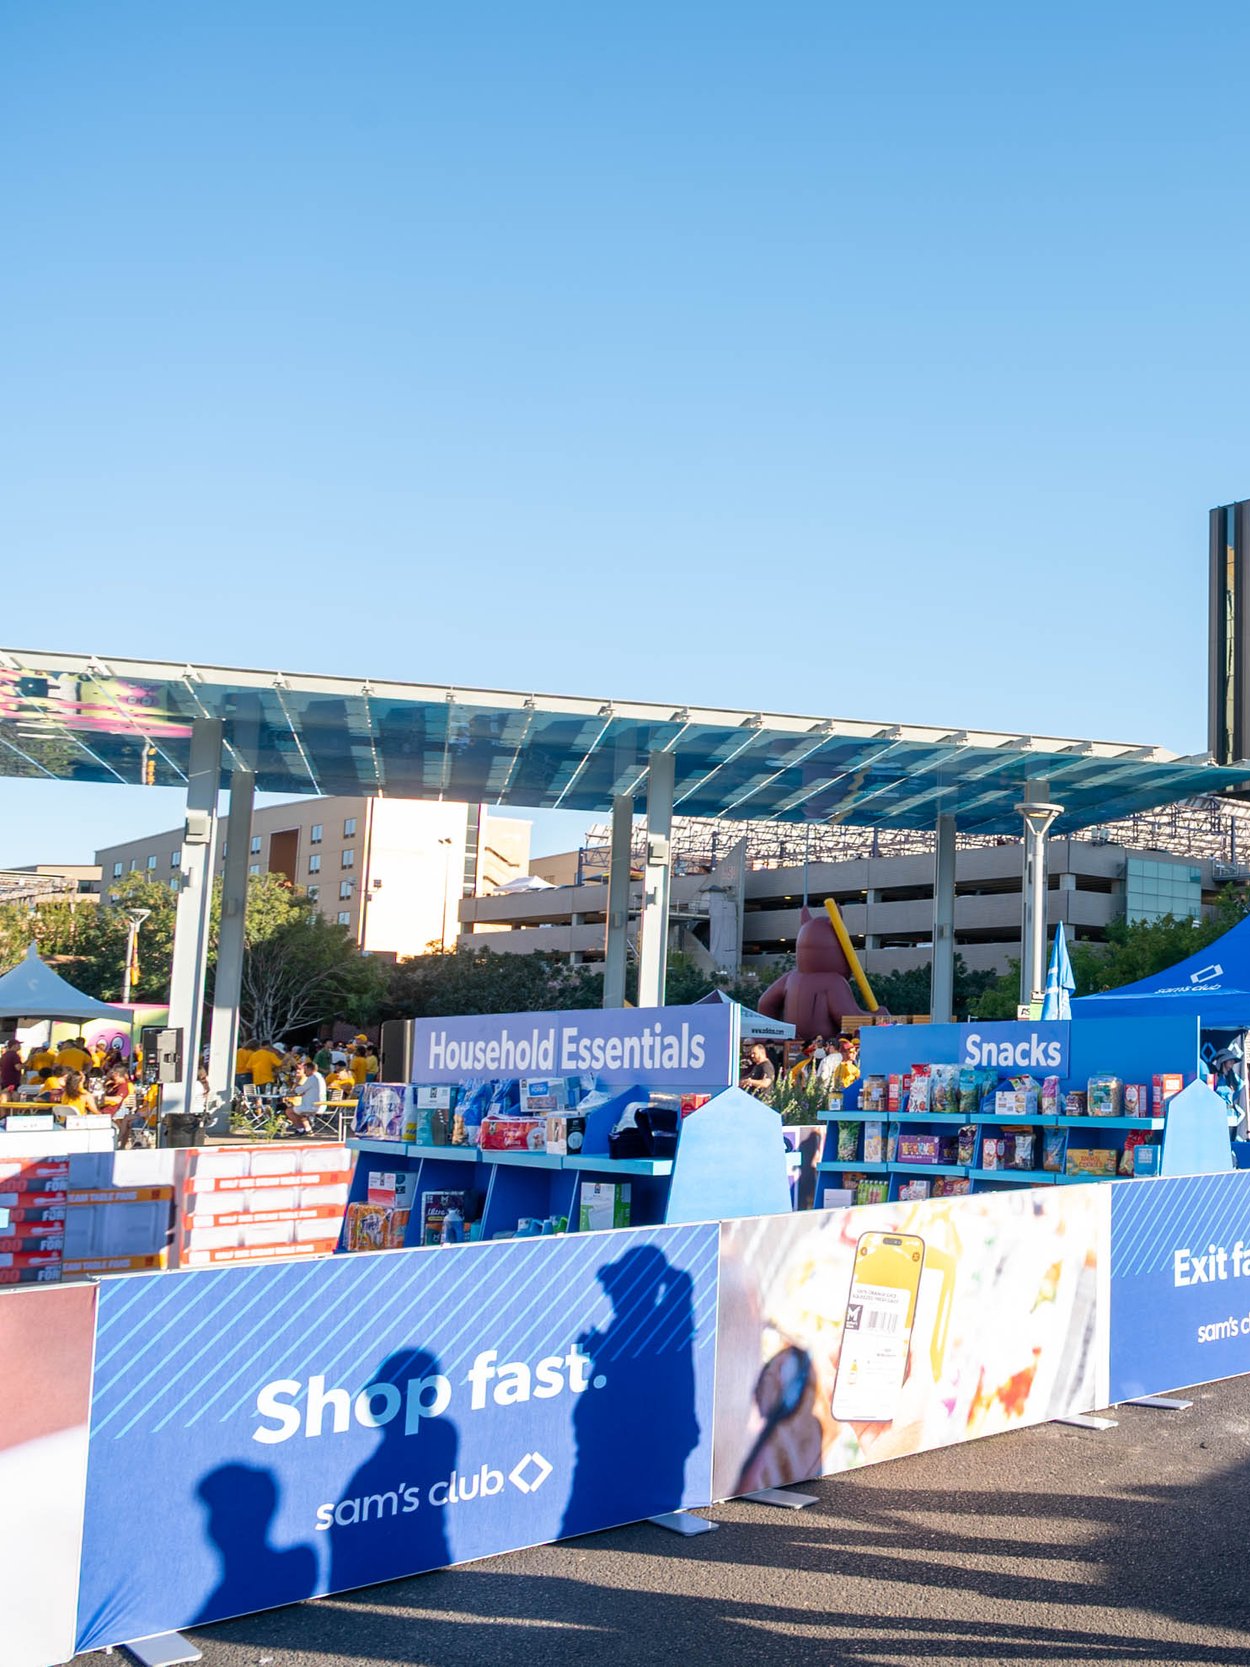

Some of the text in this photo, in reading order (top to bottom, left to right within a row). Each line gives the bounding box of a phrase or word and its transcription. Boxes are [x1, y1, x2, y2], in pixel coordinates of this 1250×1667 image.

[429, 1022, 706, 1070] Household Essentials
[965, 1033, 1062, 1068] Snacks
[1174, 1243, 1228, 1288] Exit
[1197, 1316, 1239, 1344] sam's
[252, 1343, 608, 1445] Shop fast.
[315, 1463, 504, 1531] sam's club
